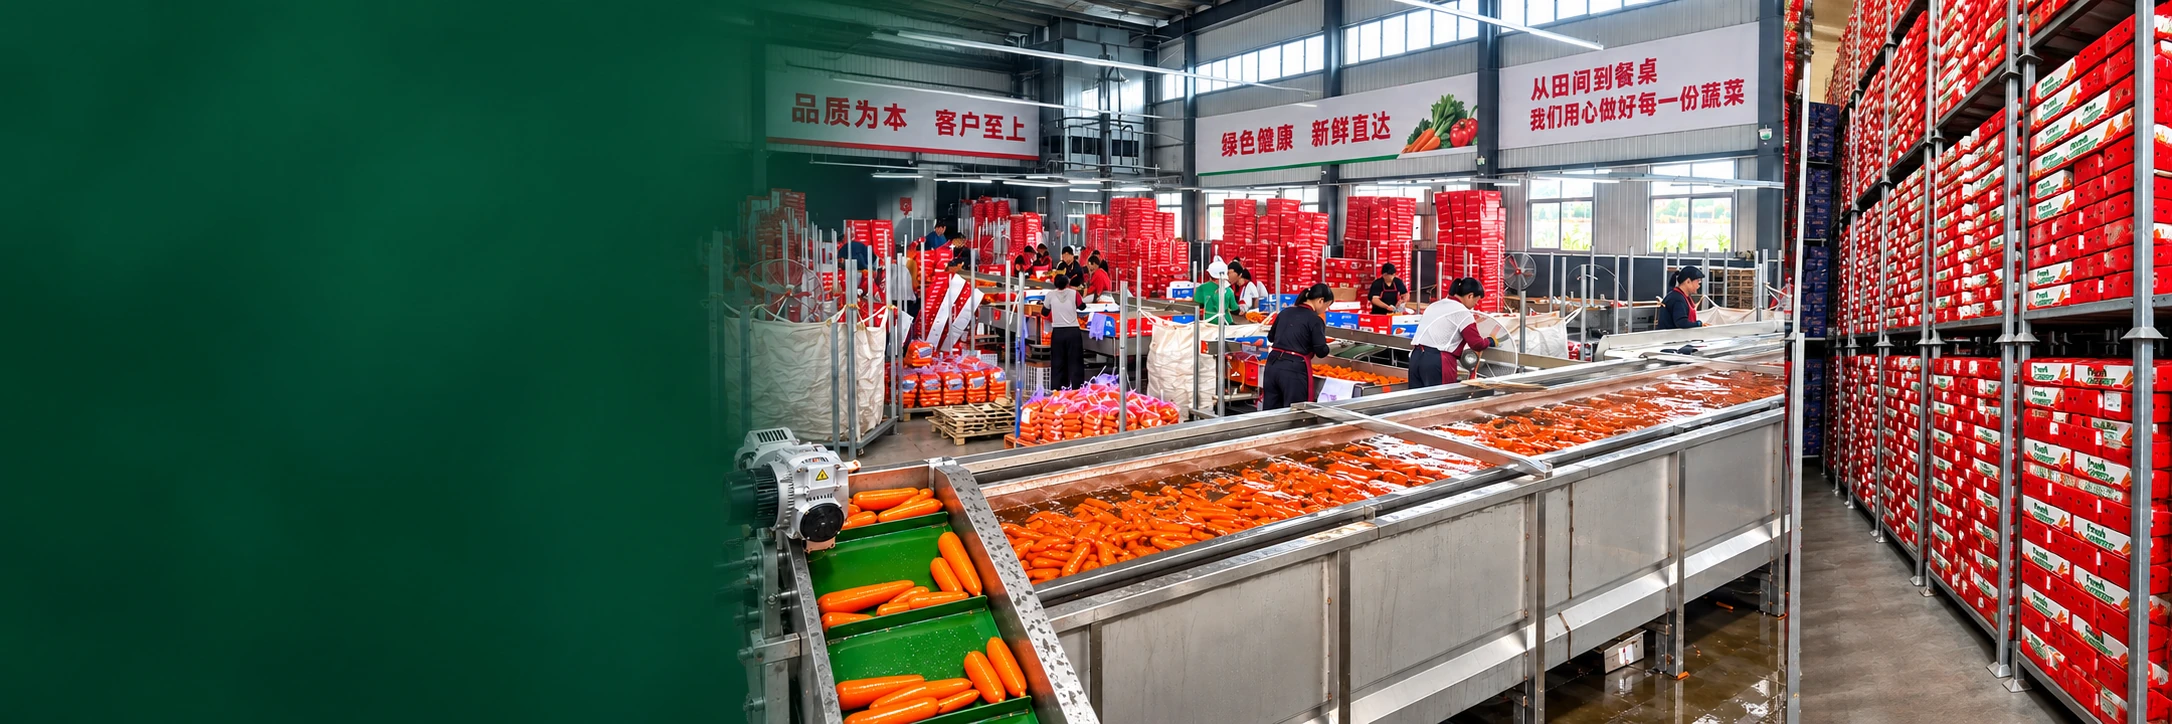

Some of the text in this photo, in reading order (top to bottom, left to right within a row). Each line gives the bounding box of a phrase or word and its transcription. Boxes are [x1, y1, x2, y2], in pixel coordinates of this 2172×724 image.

[1530, 58, 1658, 101] 从田间到餐桌
[791, 93, 1026, 142] 品质为本 客户至上
[1530, 78, 1745, 131] 我们用心做好每一份蔬菜
[1311, 111, 1391, 148] 新鲜直达
